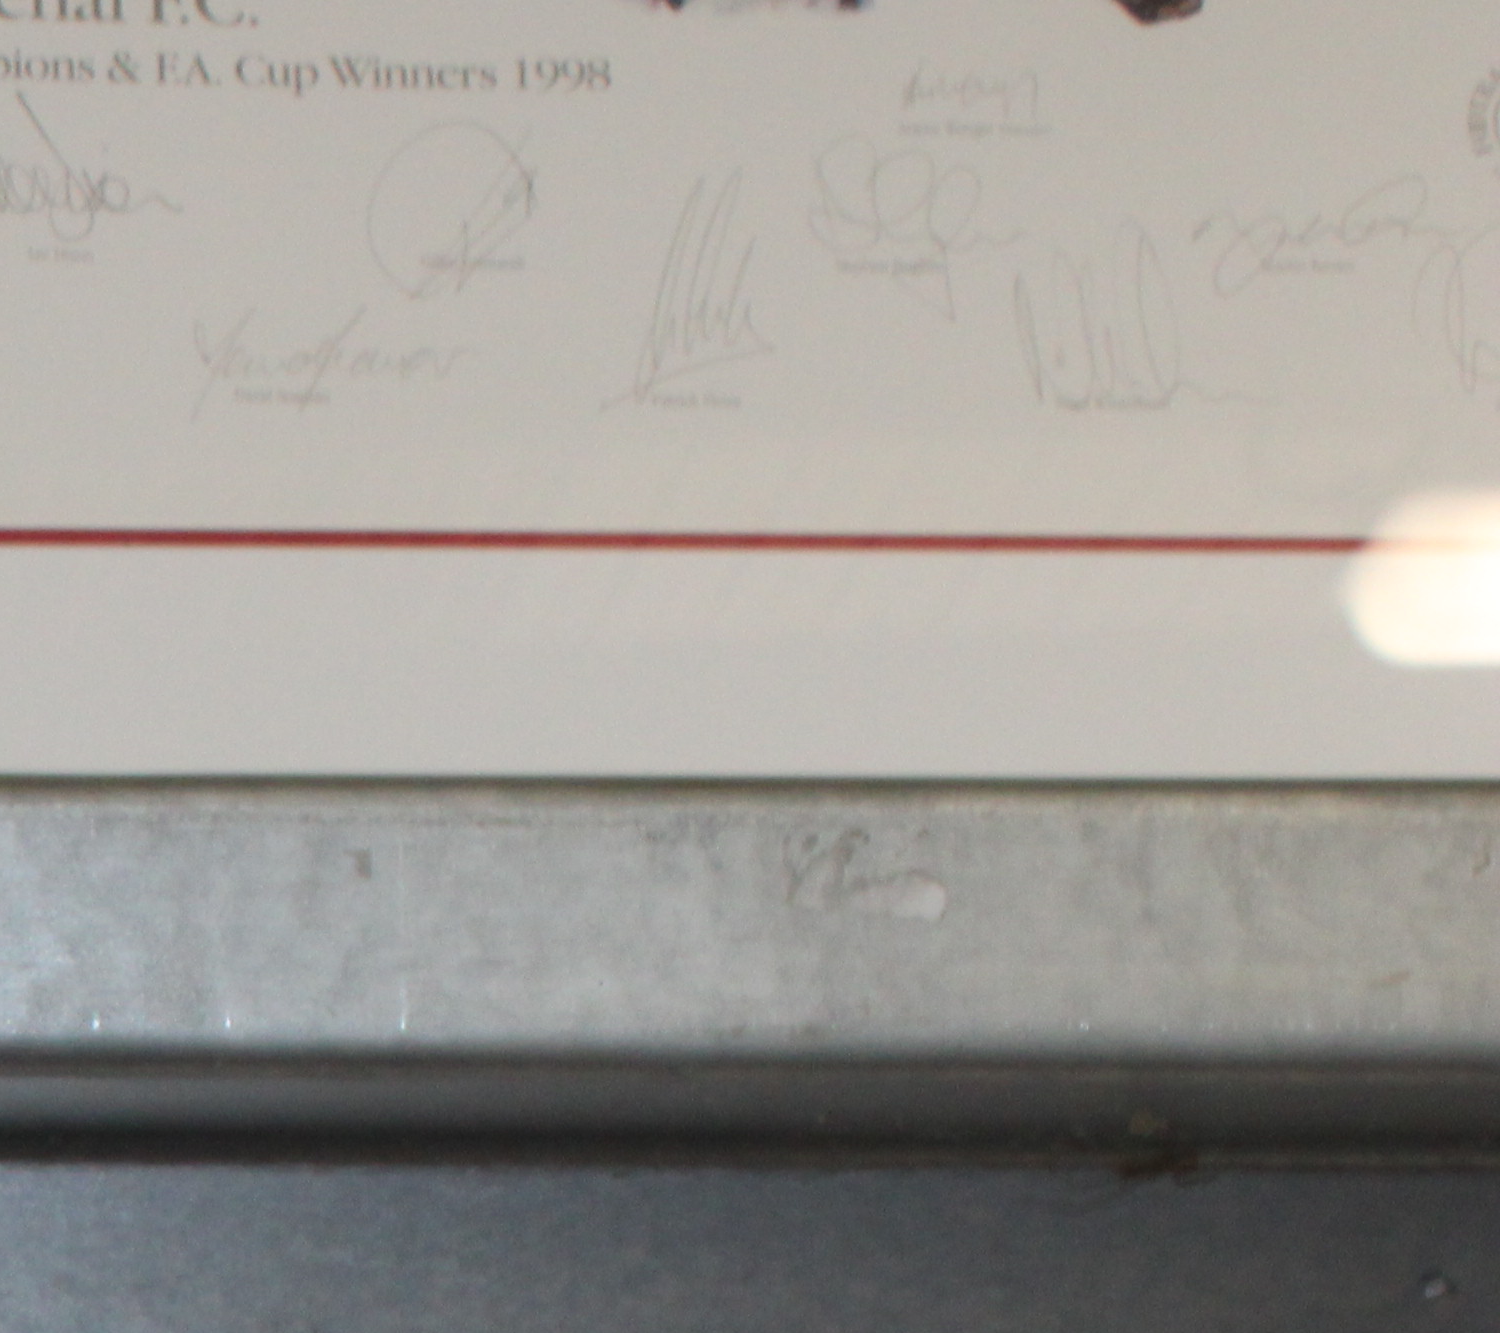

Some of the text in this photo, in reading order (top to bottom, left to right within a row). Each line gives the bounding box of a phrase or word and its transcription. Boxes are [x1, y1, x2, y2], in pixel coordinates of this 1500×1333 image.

[106, 53, 140, 83] &
[233, 54, 321, 97] Cup
[328, 54, 498, 91] Winners
[514, 56, 613, 92] 1998
